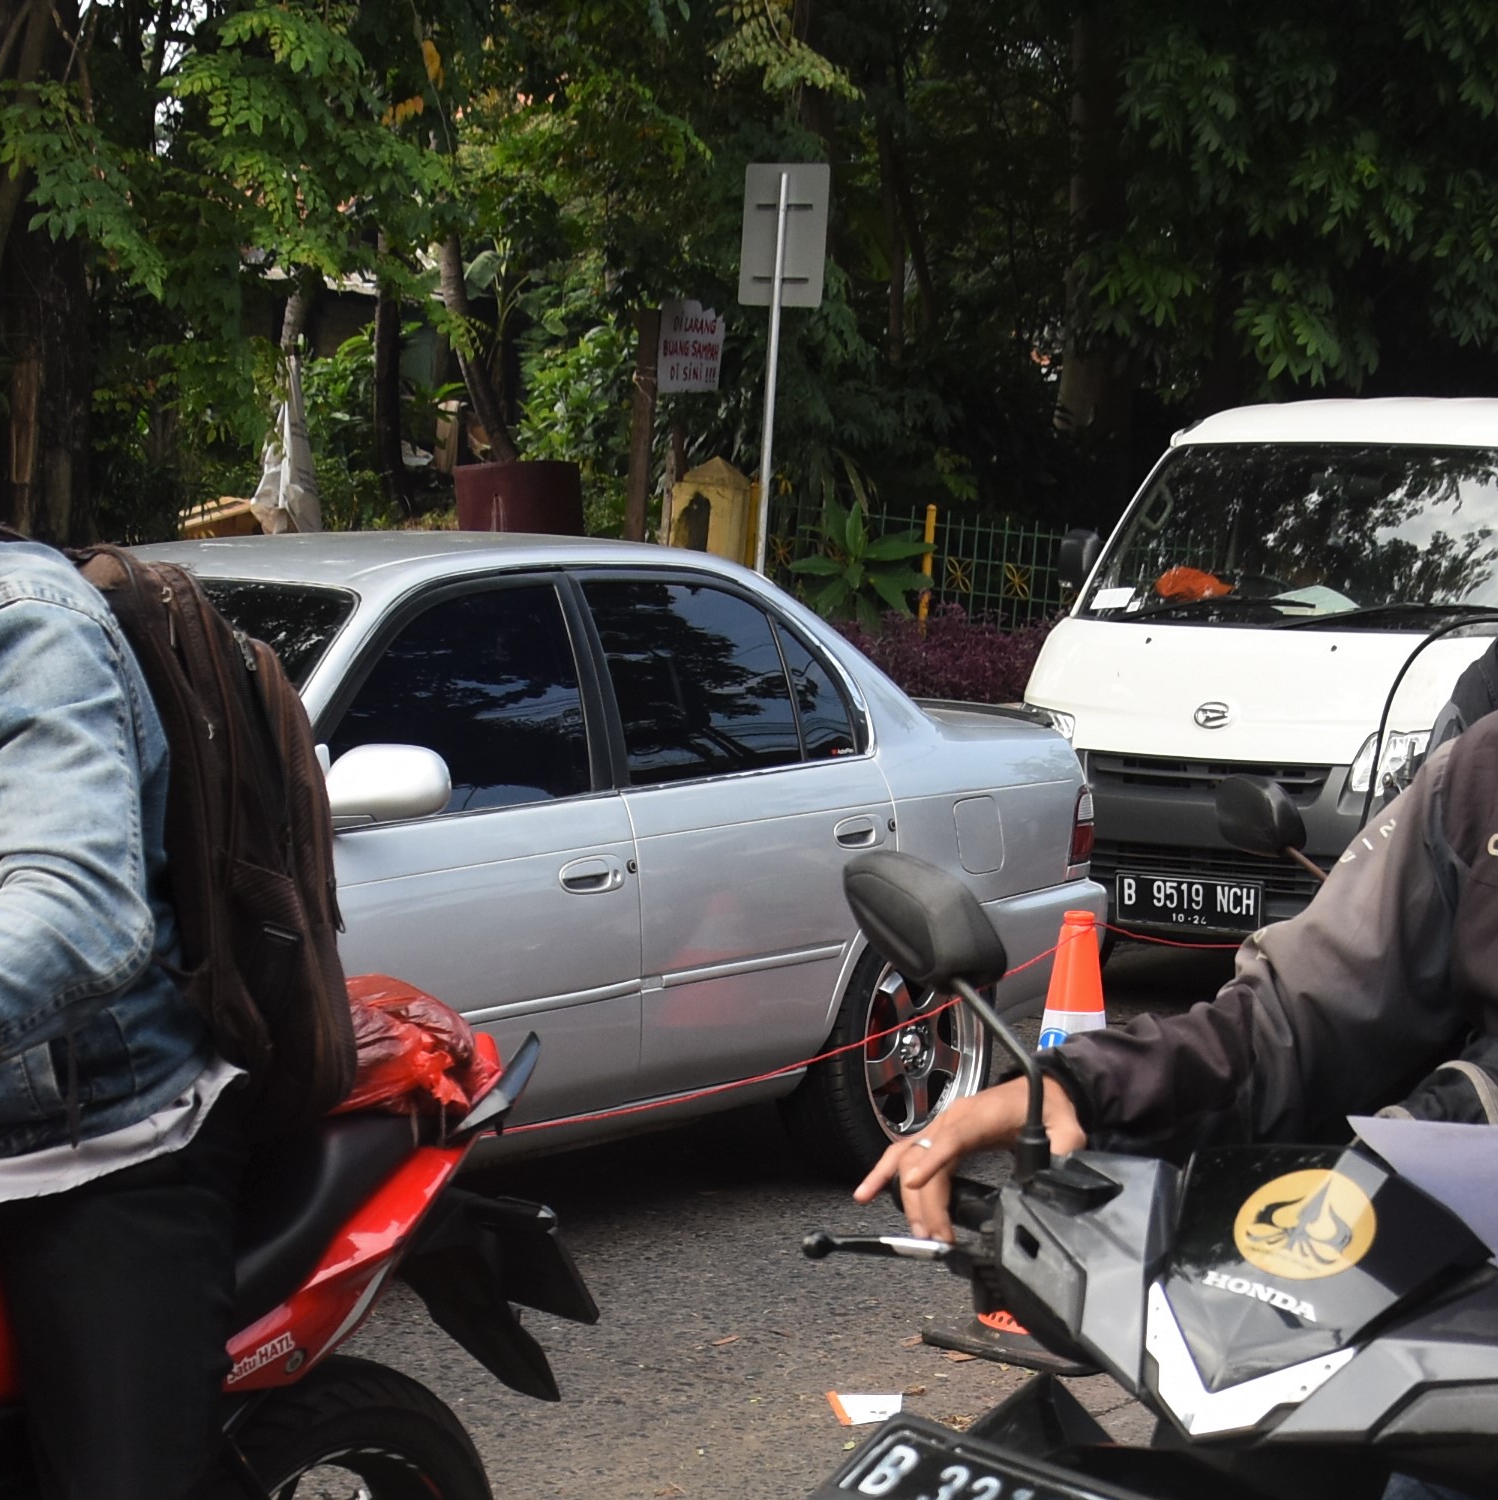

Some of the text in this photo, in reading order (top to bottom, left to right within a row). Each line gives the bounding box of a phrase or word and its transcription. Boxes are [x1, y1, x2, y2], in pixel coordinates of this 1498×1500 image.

[684, 317, 718, 335] LARANG
[663, 340, 720, 361] BUANG SAMPAH
[1123, 878, 1255, 915] B 9519 NCH
[1202, 1270, 1317, 1322] HONDA
[858, 1444, 919, 1496] B
